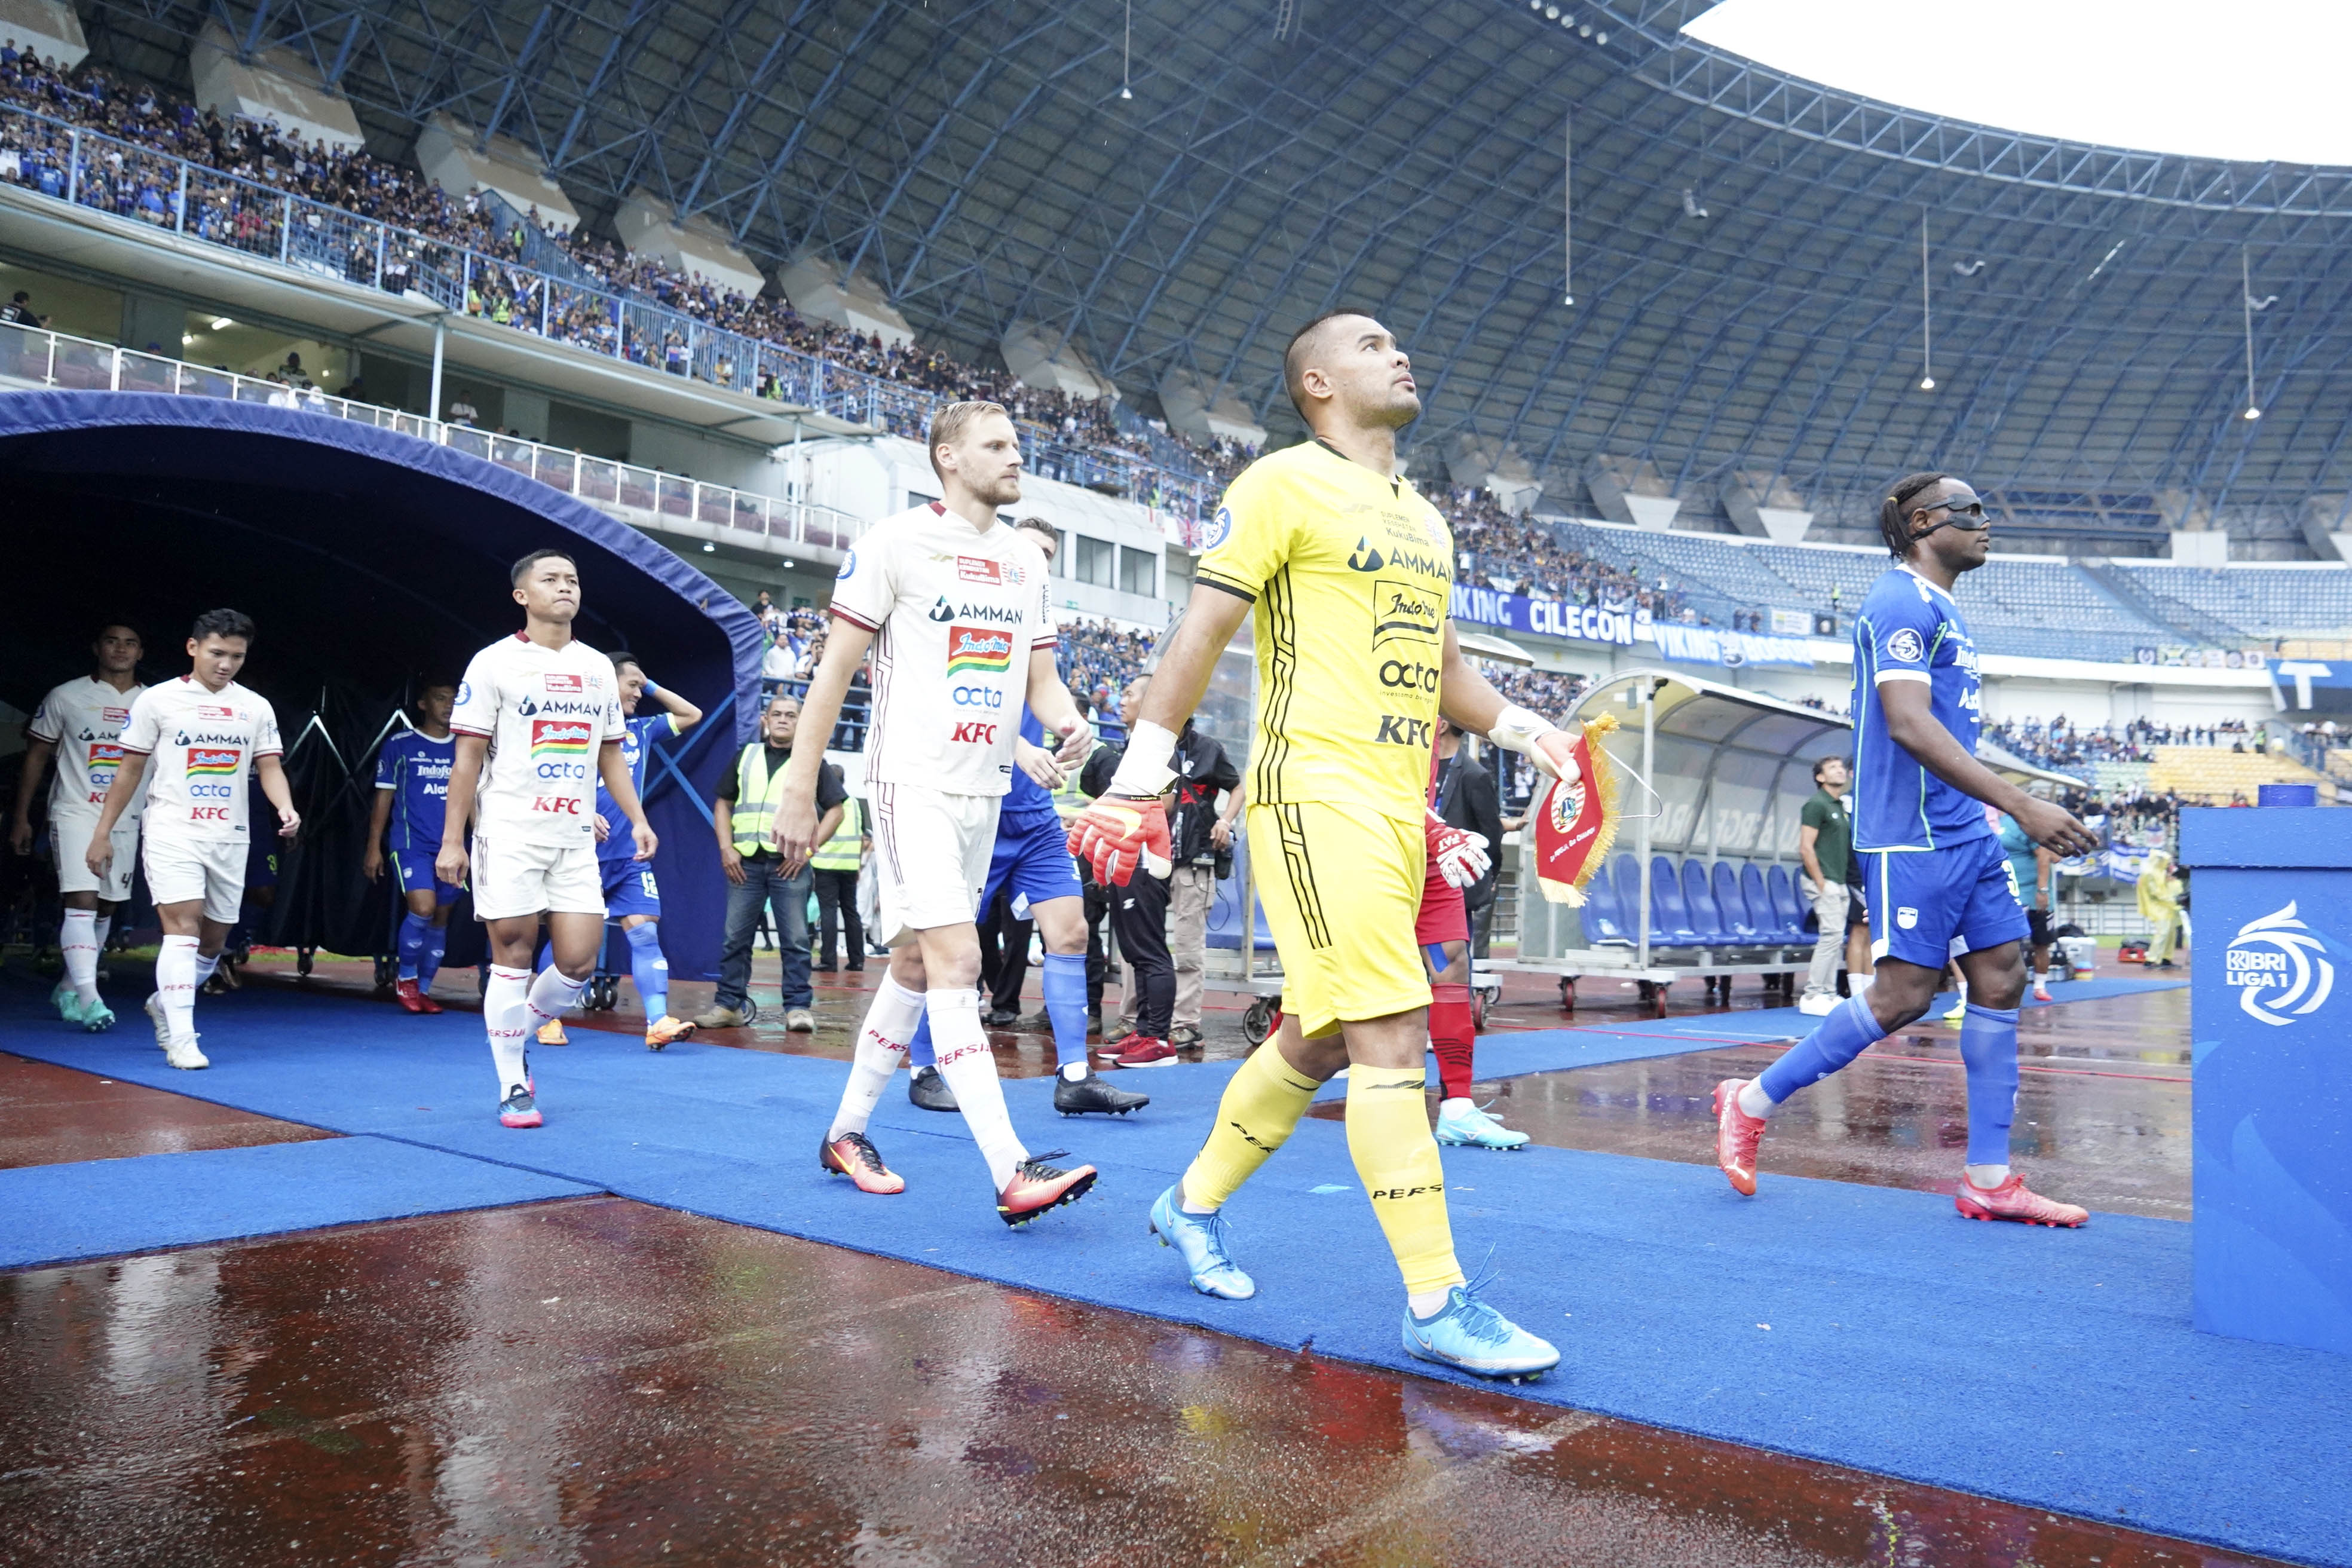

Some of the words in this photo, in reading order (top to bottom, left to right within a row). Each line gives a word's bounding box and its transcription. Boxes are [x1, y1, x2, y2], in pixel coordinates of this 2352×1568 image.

[1386, 527, 1430, 547] KukuBima
[1389, 546, 1453, 584] AMMAN
[958, 602, 1023, 625] AMMAN
[1450, 583, 1512, 626] IKING
[1529, 600, 1633, 645] CILEGON
[951, 632, 1010, 656] Indomie
[1652, 623, 1721, 661] VIKING
[1379, 660, 1440, 694] octa
[953, 687, 1002, 709] octa
[541, 700, 602, 718] AMMAN
[194, 733, 250, 746] AMMAN
[534, 724, 590, 744] Indomie
[951, 721, 997, 745] KFC
[1374, 715, 1431, 749] KFC
[416, 764, 452, 779] Indofo
[538, 762, 586, 779] octa
[190, 783, 232, 798] octa
[189, 807, 230, 820] KFC
[531, 796, 582, 815] KFC
[2250, 952, 2287, 971] BRI
[2226, 970, 2277, 987] LIGA
[2277, 973, 2288, 988] 1
[1230, 1121, 1279, 1154] PER
